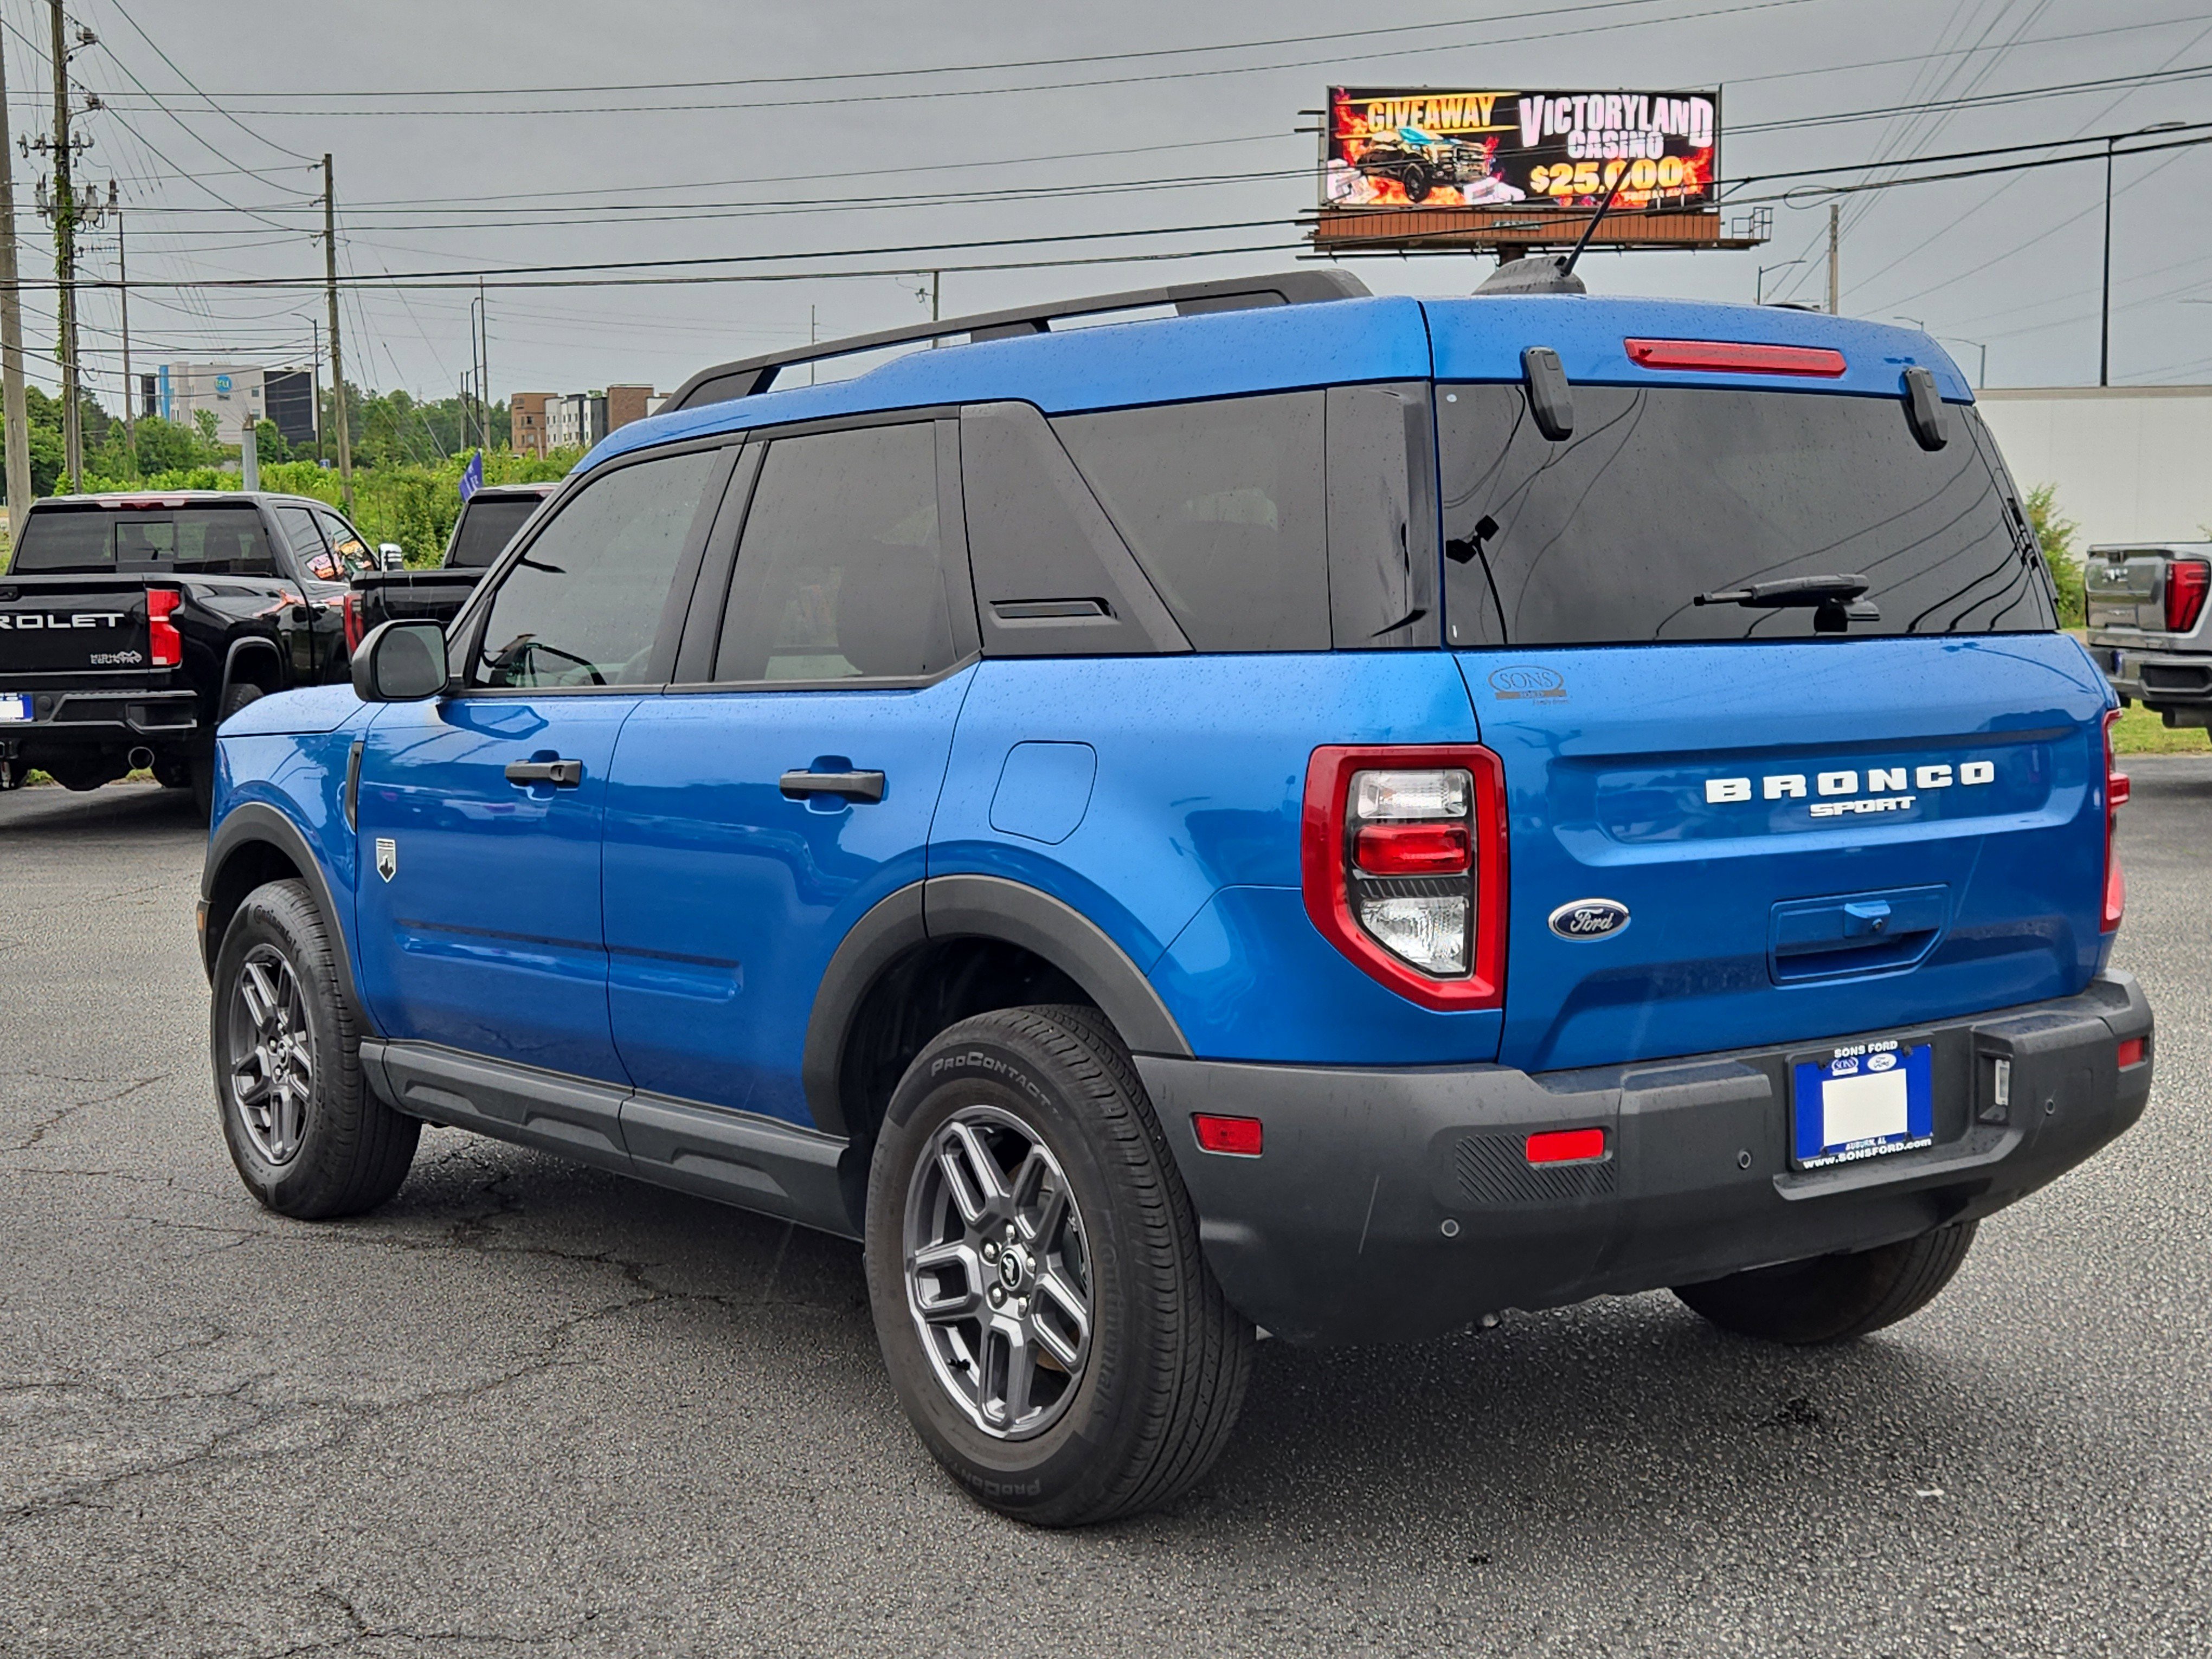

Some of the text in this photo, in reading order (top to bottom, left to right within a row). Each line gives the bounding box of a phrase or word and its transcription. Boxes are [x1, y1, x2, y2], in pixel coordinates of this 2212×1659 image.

[1367, 95, 1496, 133] GIVEAWAY
[1519, 94, 1714, 148] VICTORYLAND
[1566, 130, 1664, 160] CASINO
[1530, 156, 1684, 196] $25,000
[1500, 671, 1553, 690] SONS
[1705, 760, 1995, 803] BRONCO
[1810, 796, 1917, 817] SPORT
[1570, 908, 1615, 933] Ford
[1834, 1040, 1898, 1058] SONS FORD
[1803, 1138, 1932, 1169] www.SONSFORD.com
